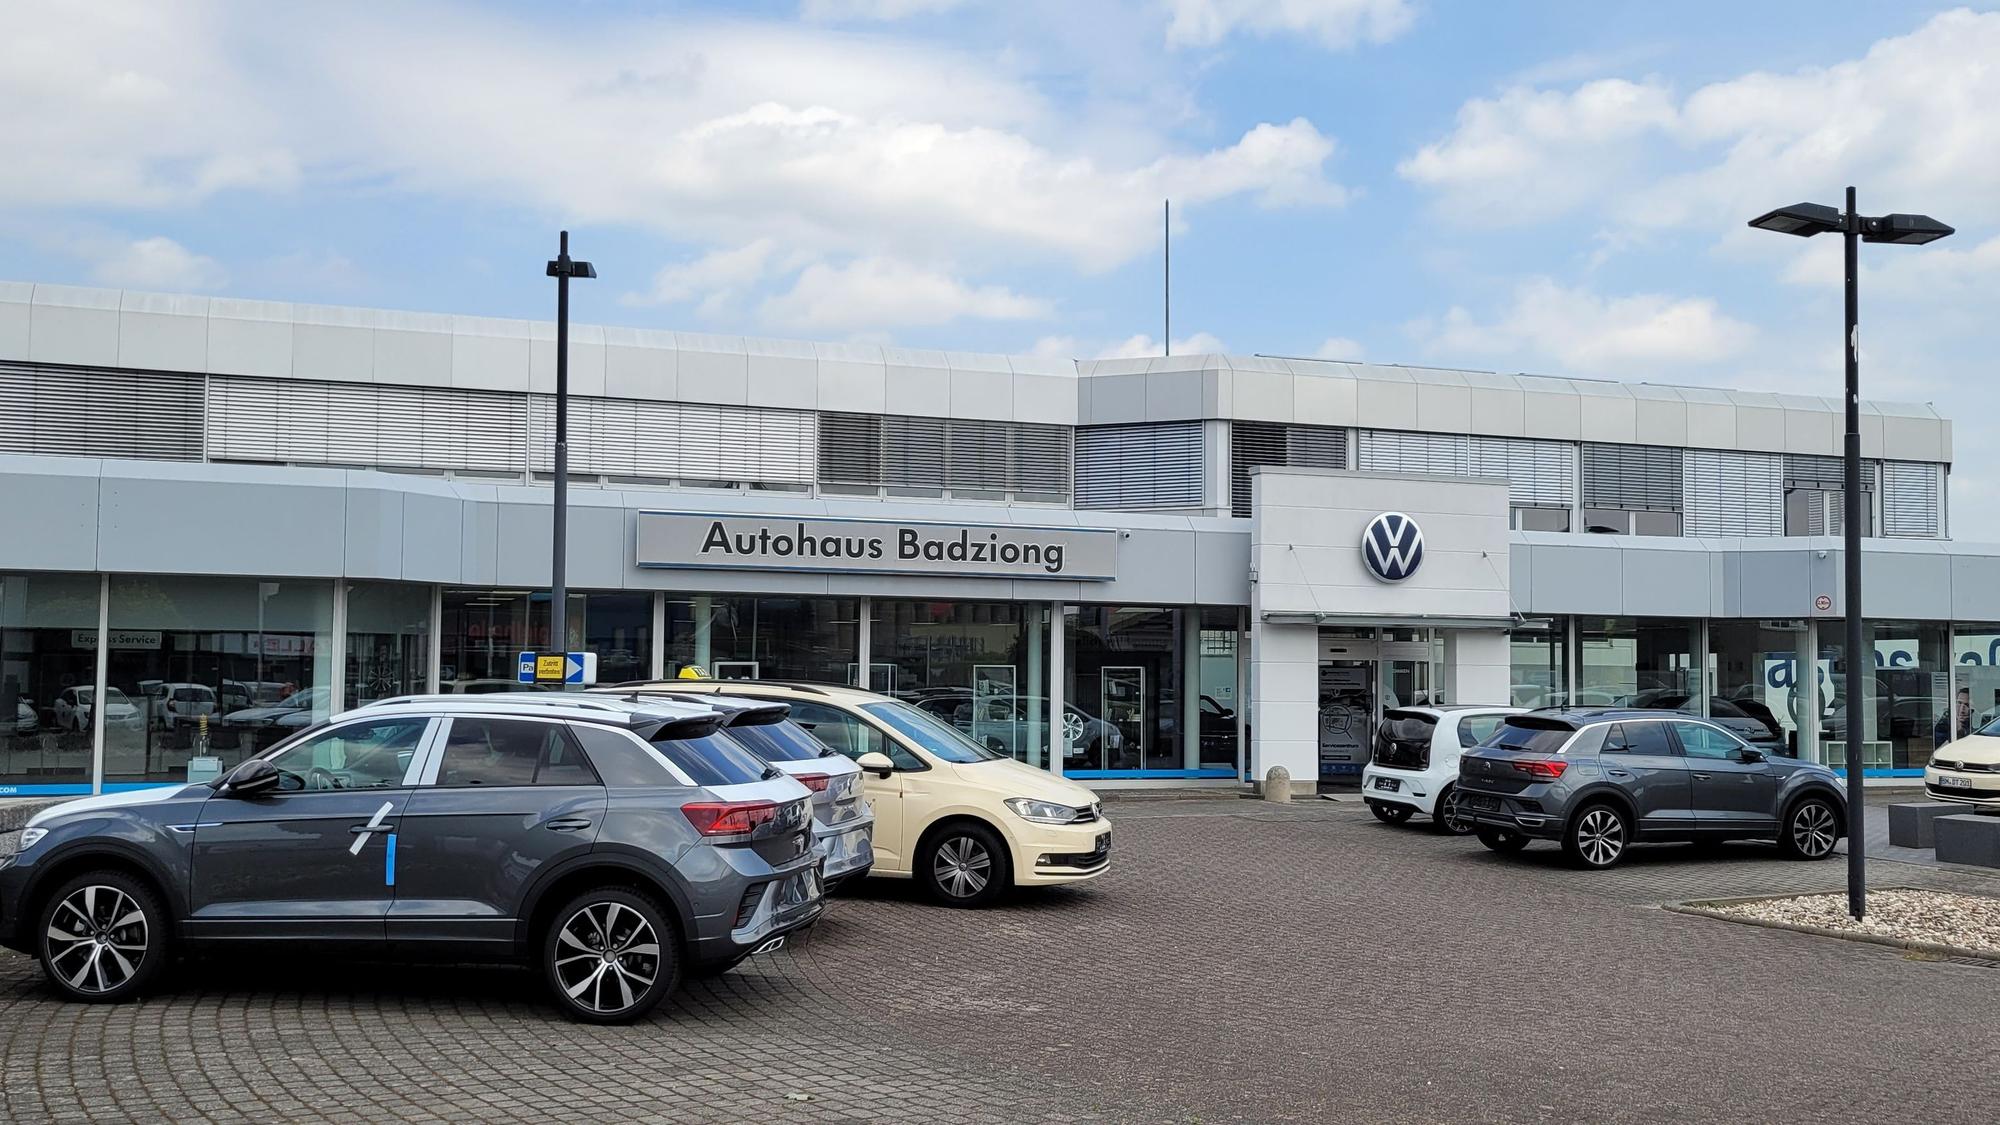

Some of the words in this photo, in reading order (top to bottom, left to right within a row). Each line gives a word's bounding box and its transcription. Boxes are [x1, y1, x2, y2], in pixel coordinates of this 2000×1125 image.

[701, 521, 883, 559] Autohaus
[898, 528, 1064, 573] Badziong
[119, 633, 156, 645] Service
